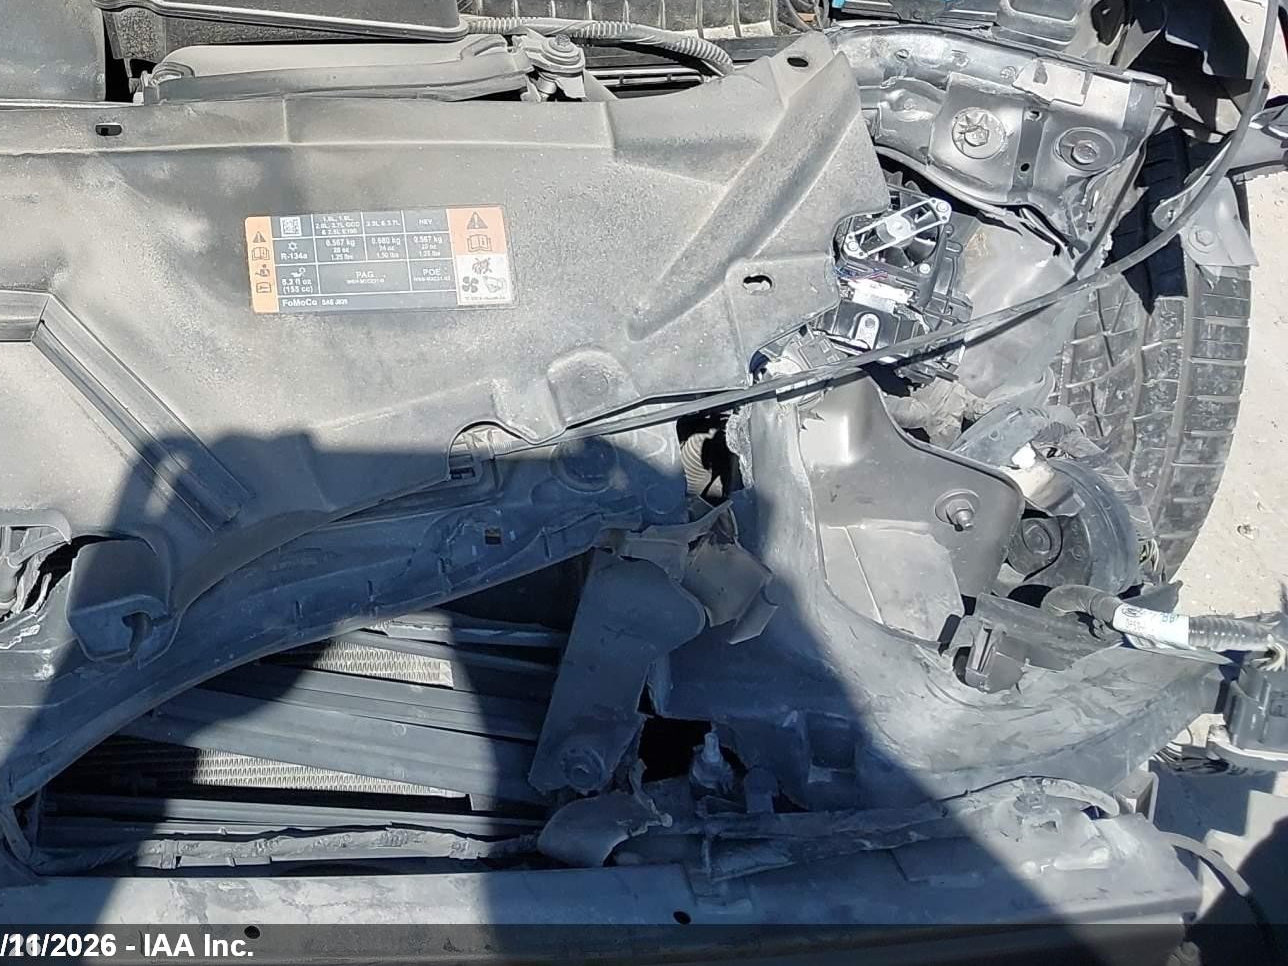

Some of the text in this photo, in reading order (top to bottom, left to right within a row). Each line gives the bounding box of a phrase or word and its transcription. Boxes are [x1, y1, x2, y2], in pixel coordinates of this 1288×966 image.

[346, 239, 356, 247] kg
[392, 237, 401, 245] kg
[433, 235, 442, 244] kg
[281, 252, 308, 260] R-134a
[282, 298, 318, 307] FoMoCo
